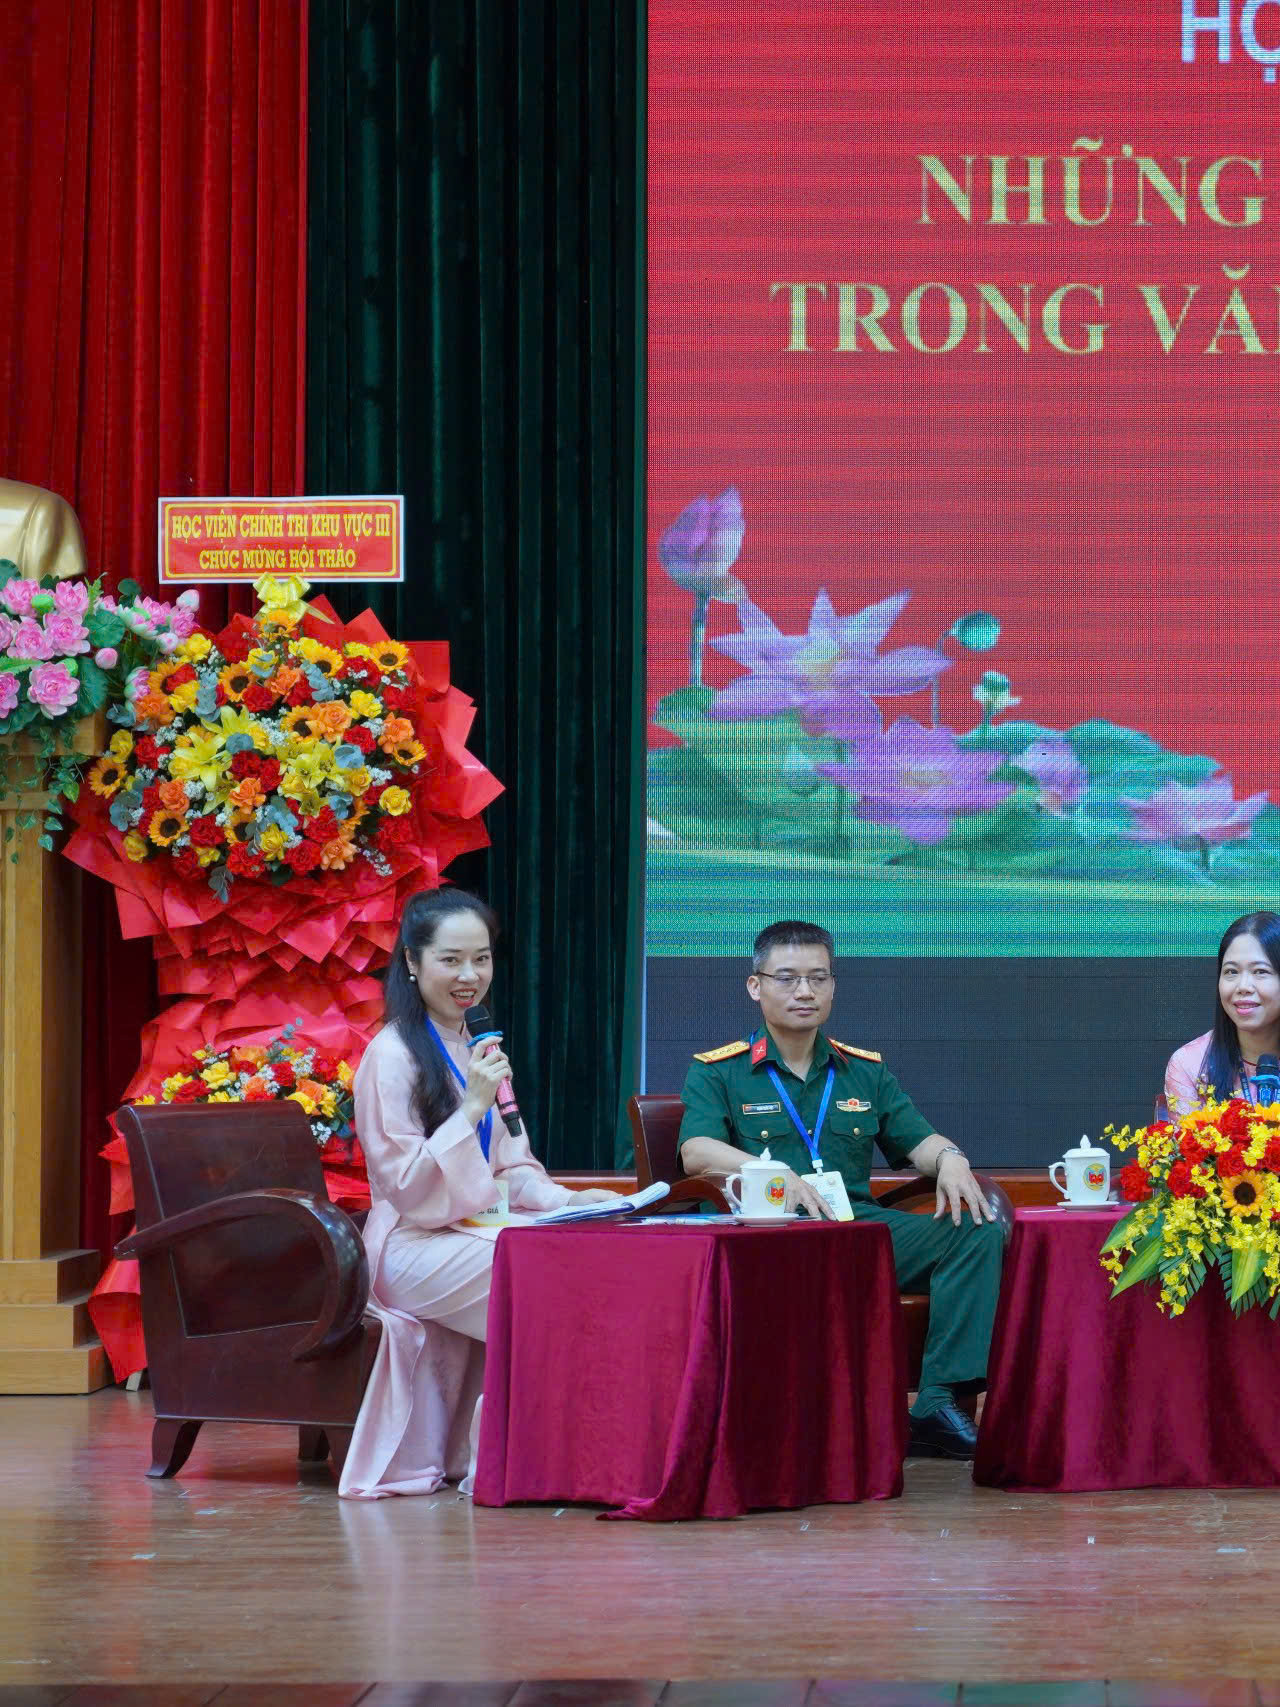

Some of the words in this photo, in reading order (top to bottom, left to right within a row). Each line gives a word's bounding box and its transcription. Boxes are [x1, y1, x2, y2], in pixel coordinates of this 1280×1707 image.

[917, 137, 1267, 229] NHỮNG
[769, 281, 1111, 357] TRONG
[172, 515, 202, 544] HỌC
[205, 508, 237, 544] VIỆN
[240, 508, 284, 538] CHÍNH
[286, 513, 309, 542] TRỊ
[311, 513, 340, 537] KHU
[343, 512, 373, 542] VỰC
[375, 513, 391, 537] III
[199, 545, 239, 569] CHÚC
[242, 544, 286, 569] MỪNG
[288, 544, 315, 573] HỘI
[317, 542, 356, 569] THẢO
